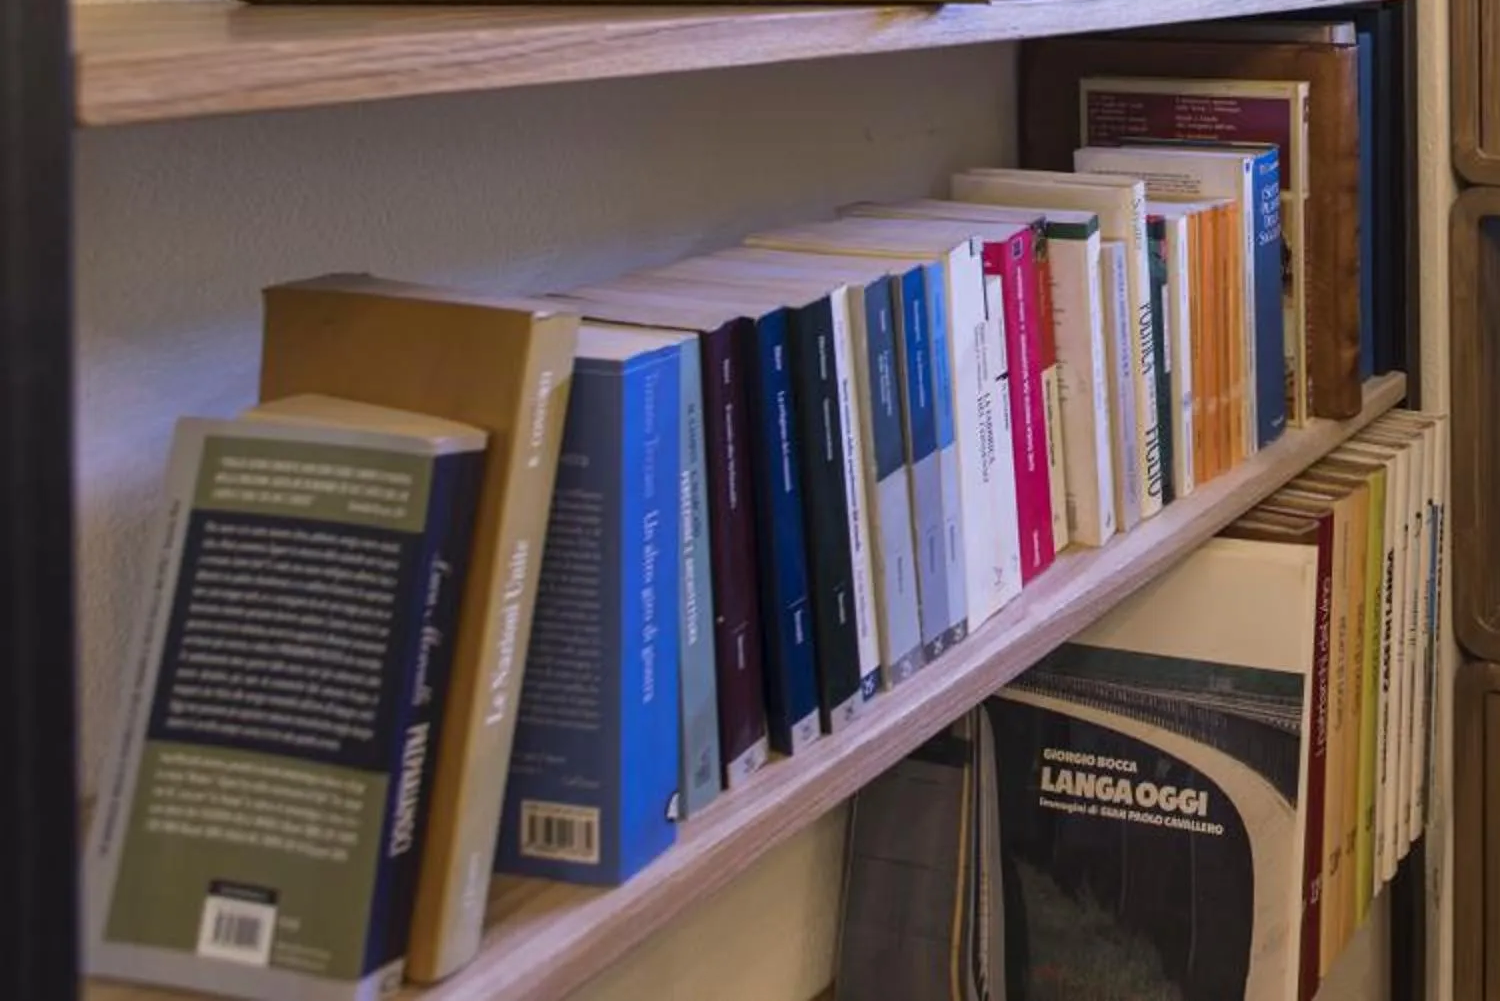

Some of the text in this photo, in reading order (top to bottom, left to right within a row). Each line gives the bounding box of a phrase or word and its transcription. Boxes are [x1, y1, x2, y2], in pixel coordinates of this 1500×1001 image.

[486, 539, 529, 726] Le Nazioni Unite
[1043, 748, 1138, 773] GIORGIO BOCCA
[1041, 766, 1209, 817] LANGA OGGI
[1128, 810, 1163, 826] PAOLO
[1165, 816, 1225, 836] CAVALLERO
